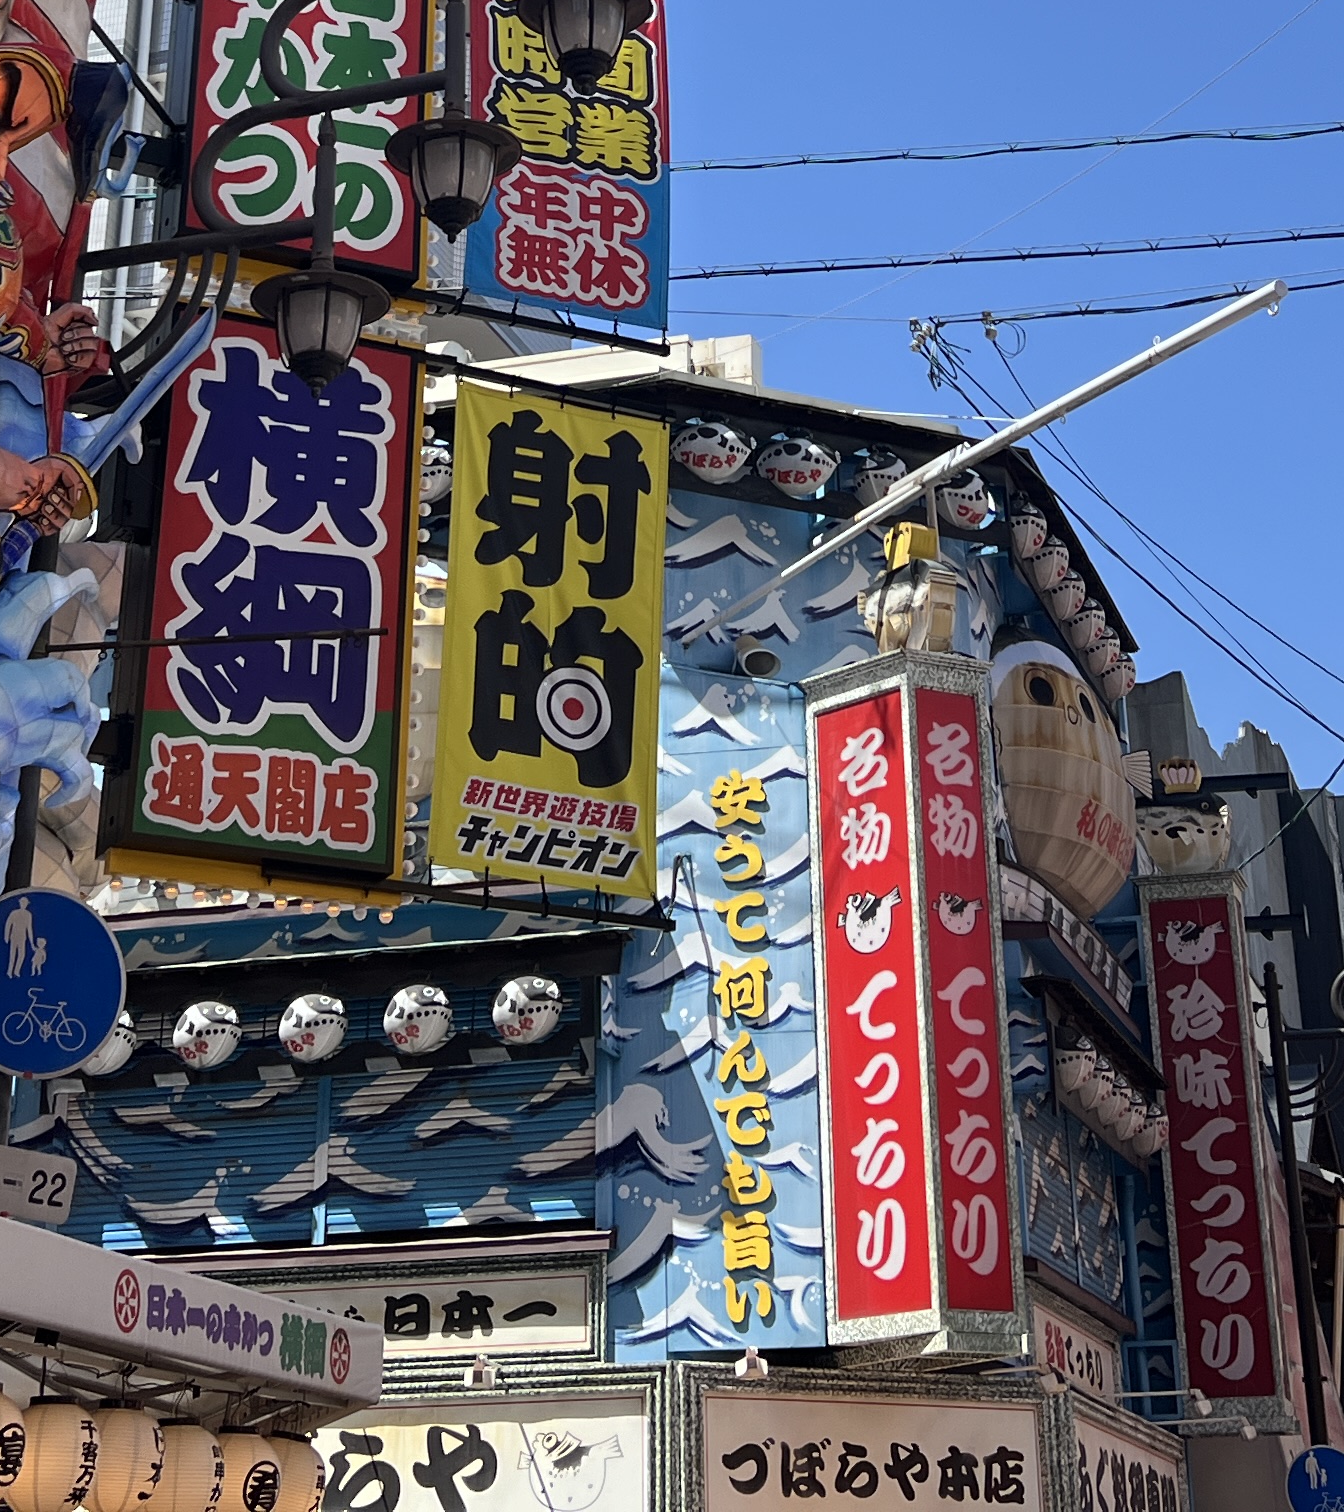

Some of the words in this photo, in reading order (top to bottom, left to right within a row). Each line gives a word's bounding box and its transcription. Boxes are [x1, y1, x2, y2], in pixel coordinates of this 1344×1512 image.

[174, 344, 386, 746] 横綱
[468, 408, 652, 788] 射的
[147, 742, 374, 846] 通天閣店
[461, 778, 639, 832] 新世界遊技場
[457, 816, 639, 878] チャンピオン
[708, 768, 773, 1325] 安うて何んでも旨い
[845, 968, 907, 1282] てっちり
[937, 965, 999, 1277] てっちり
[146, 1284, 275, 1357] 日本一の串かつ
[383, 1291, 558, 1357] 日本一
[64, 1419, 98, 1506] 千客万来
[721, 1437, 1026, 1505] づぼらや本店
